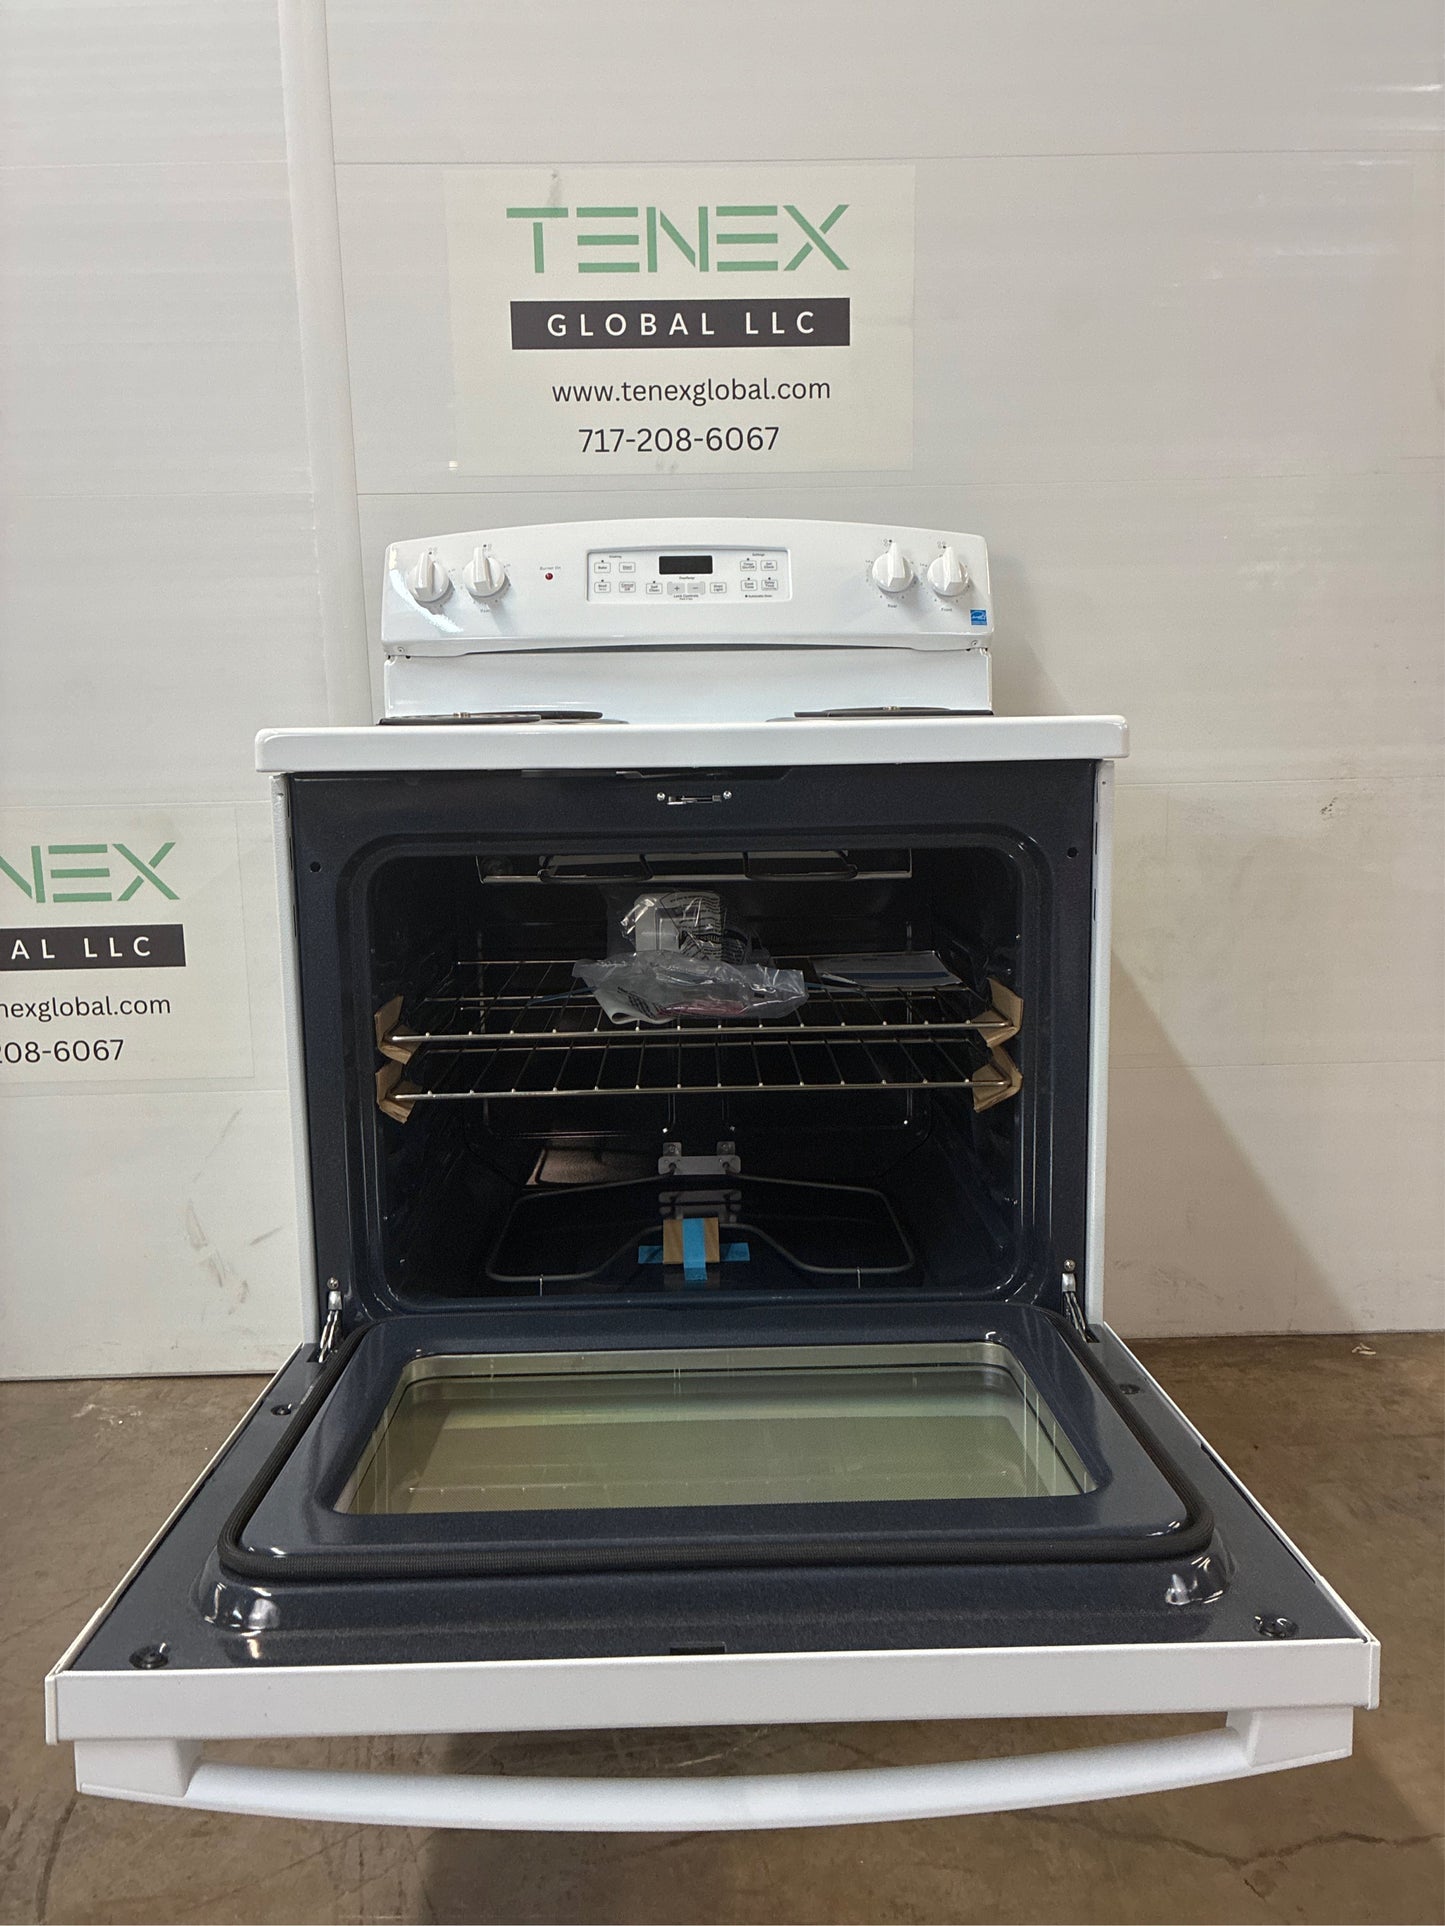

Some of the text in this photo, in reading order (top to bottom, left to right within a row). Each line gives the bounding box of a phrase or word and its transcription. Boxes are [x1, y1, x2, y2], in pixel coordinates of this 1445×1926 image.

[506, 204, 850, 273] TENEX
[547, 311, 815, 337] GLOBAL LLC
[551, 377, 832, 407] www.tenexglobal.com
[578, 426, 781, 453] 717-208-6067
[0, 842, 180, 903] NEX
[83, 936, 152, 958] LLC
[0, 1039, 124, 1064] 08-6067
